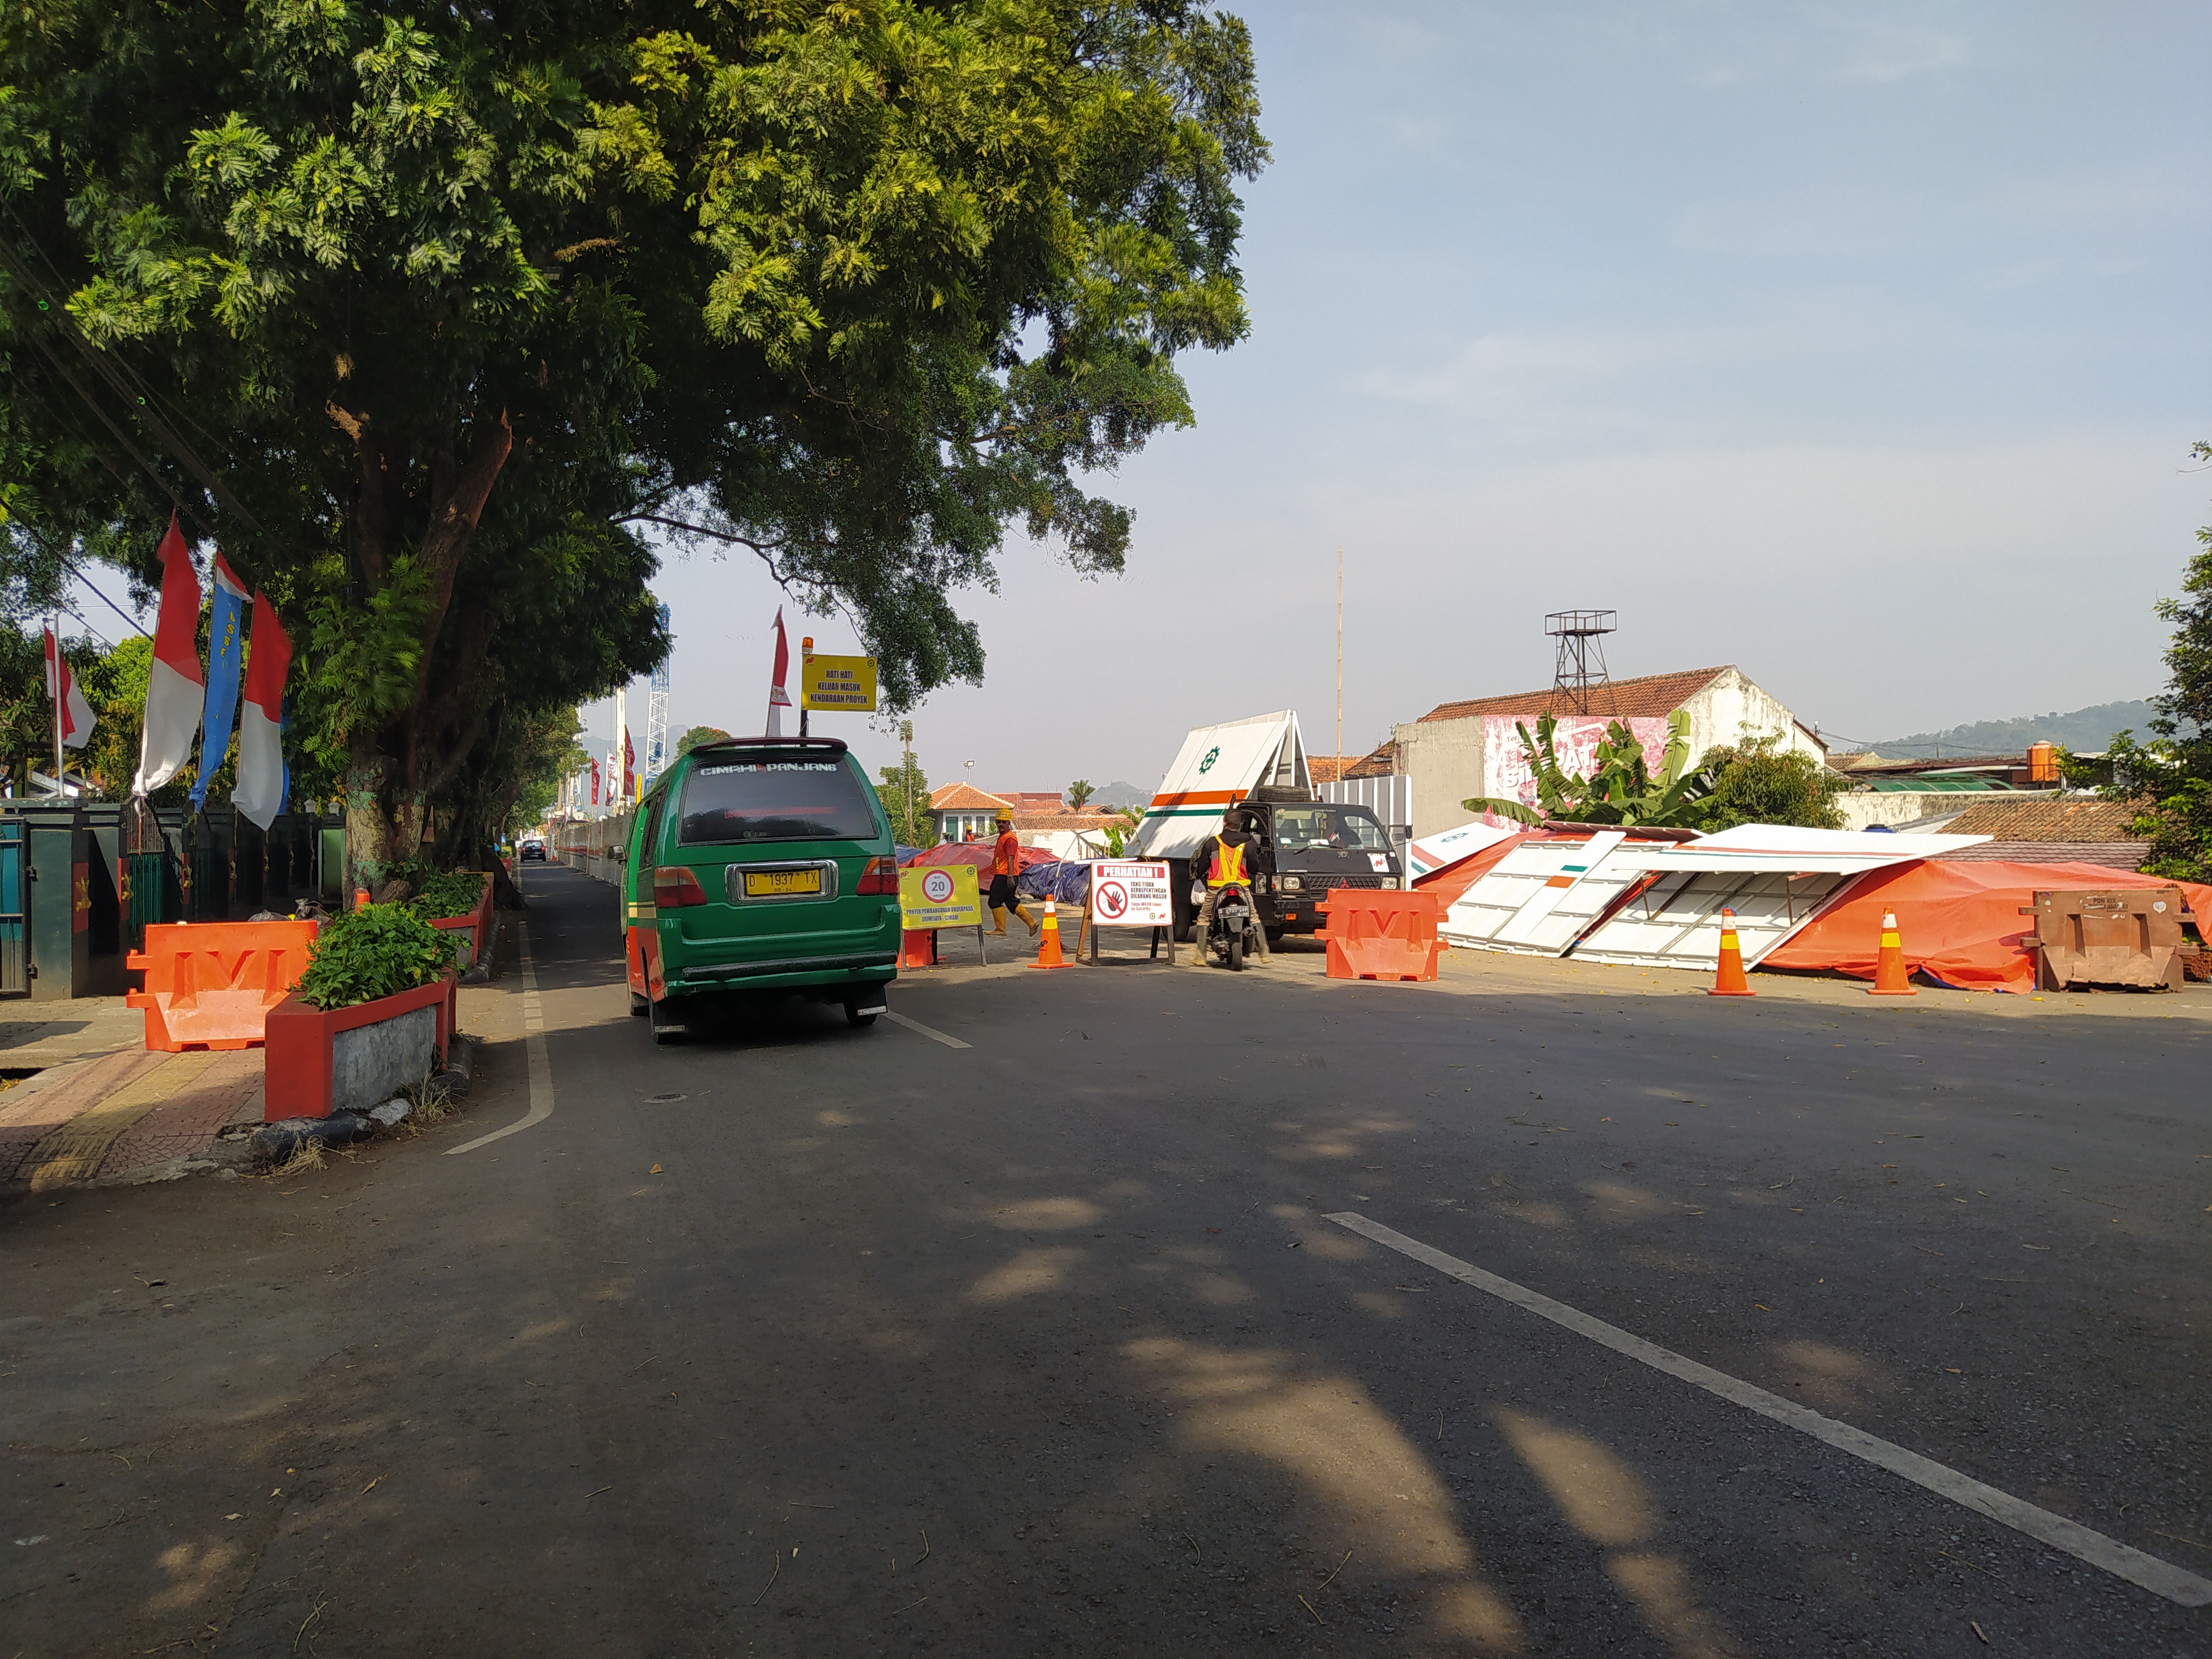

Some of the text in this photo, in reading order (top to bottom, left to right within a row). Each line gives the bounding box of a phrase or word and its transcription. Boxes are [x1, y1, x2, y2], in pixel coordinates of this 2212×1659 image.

[826, 670, 853, 679] HATI HATI
[817, 682, 861, 692] KELUAR MASUK
[810, 693, 868, 703] KENDARAAN PROYEK
[700, 763, 837, 776] CIMAHI PANJANG
[1103, 866, 1158, 878] PERHATIAN !
[749, 872, 817, 887] D 1937 TX
[931, 881, 945, 891] 20
